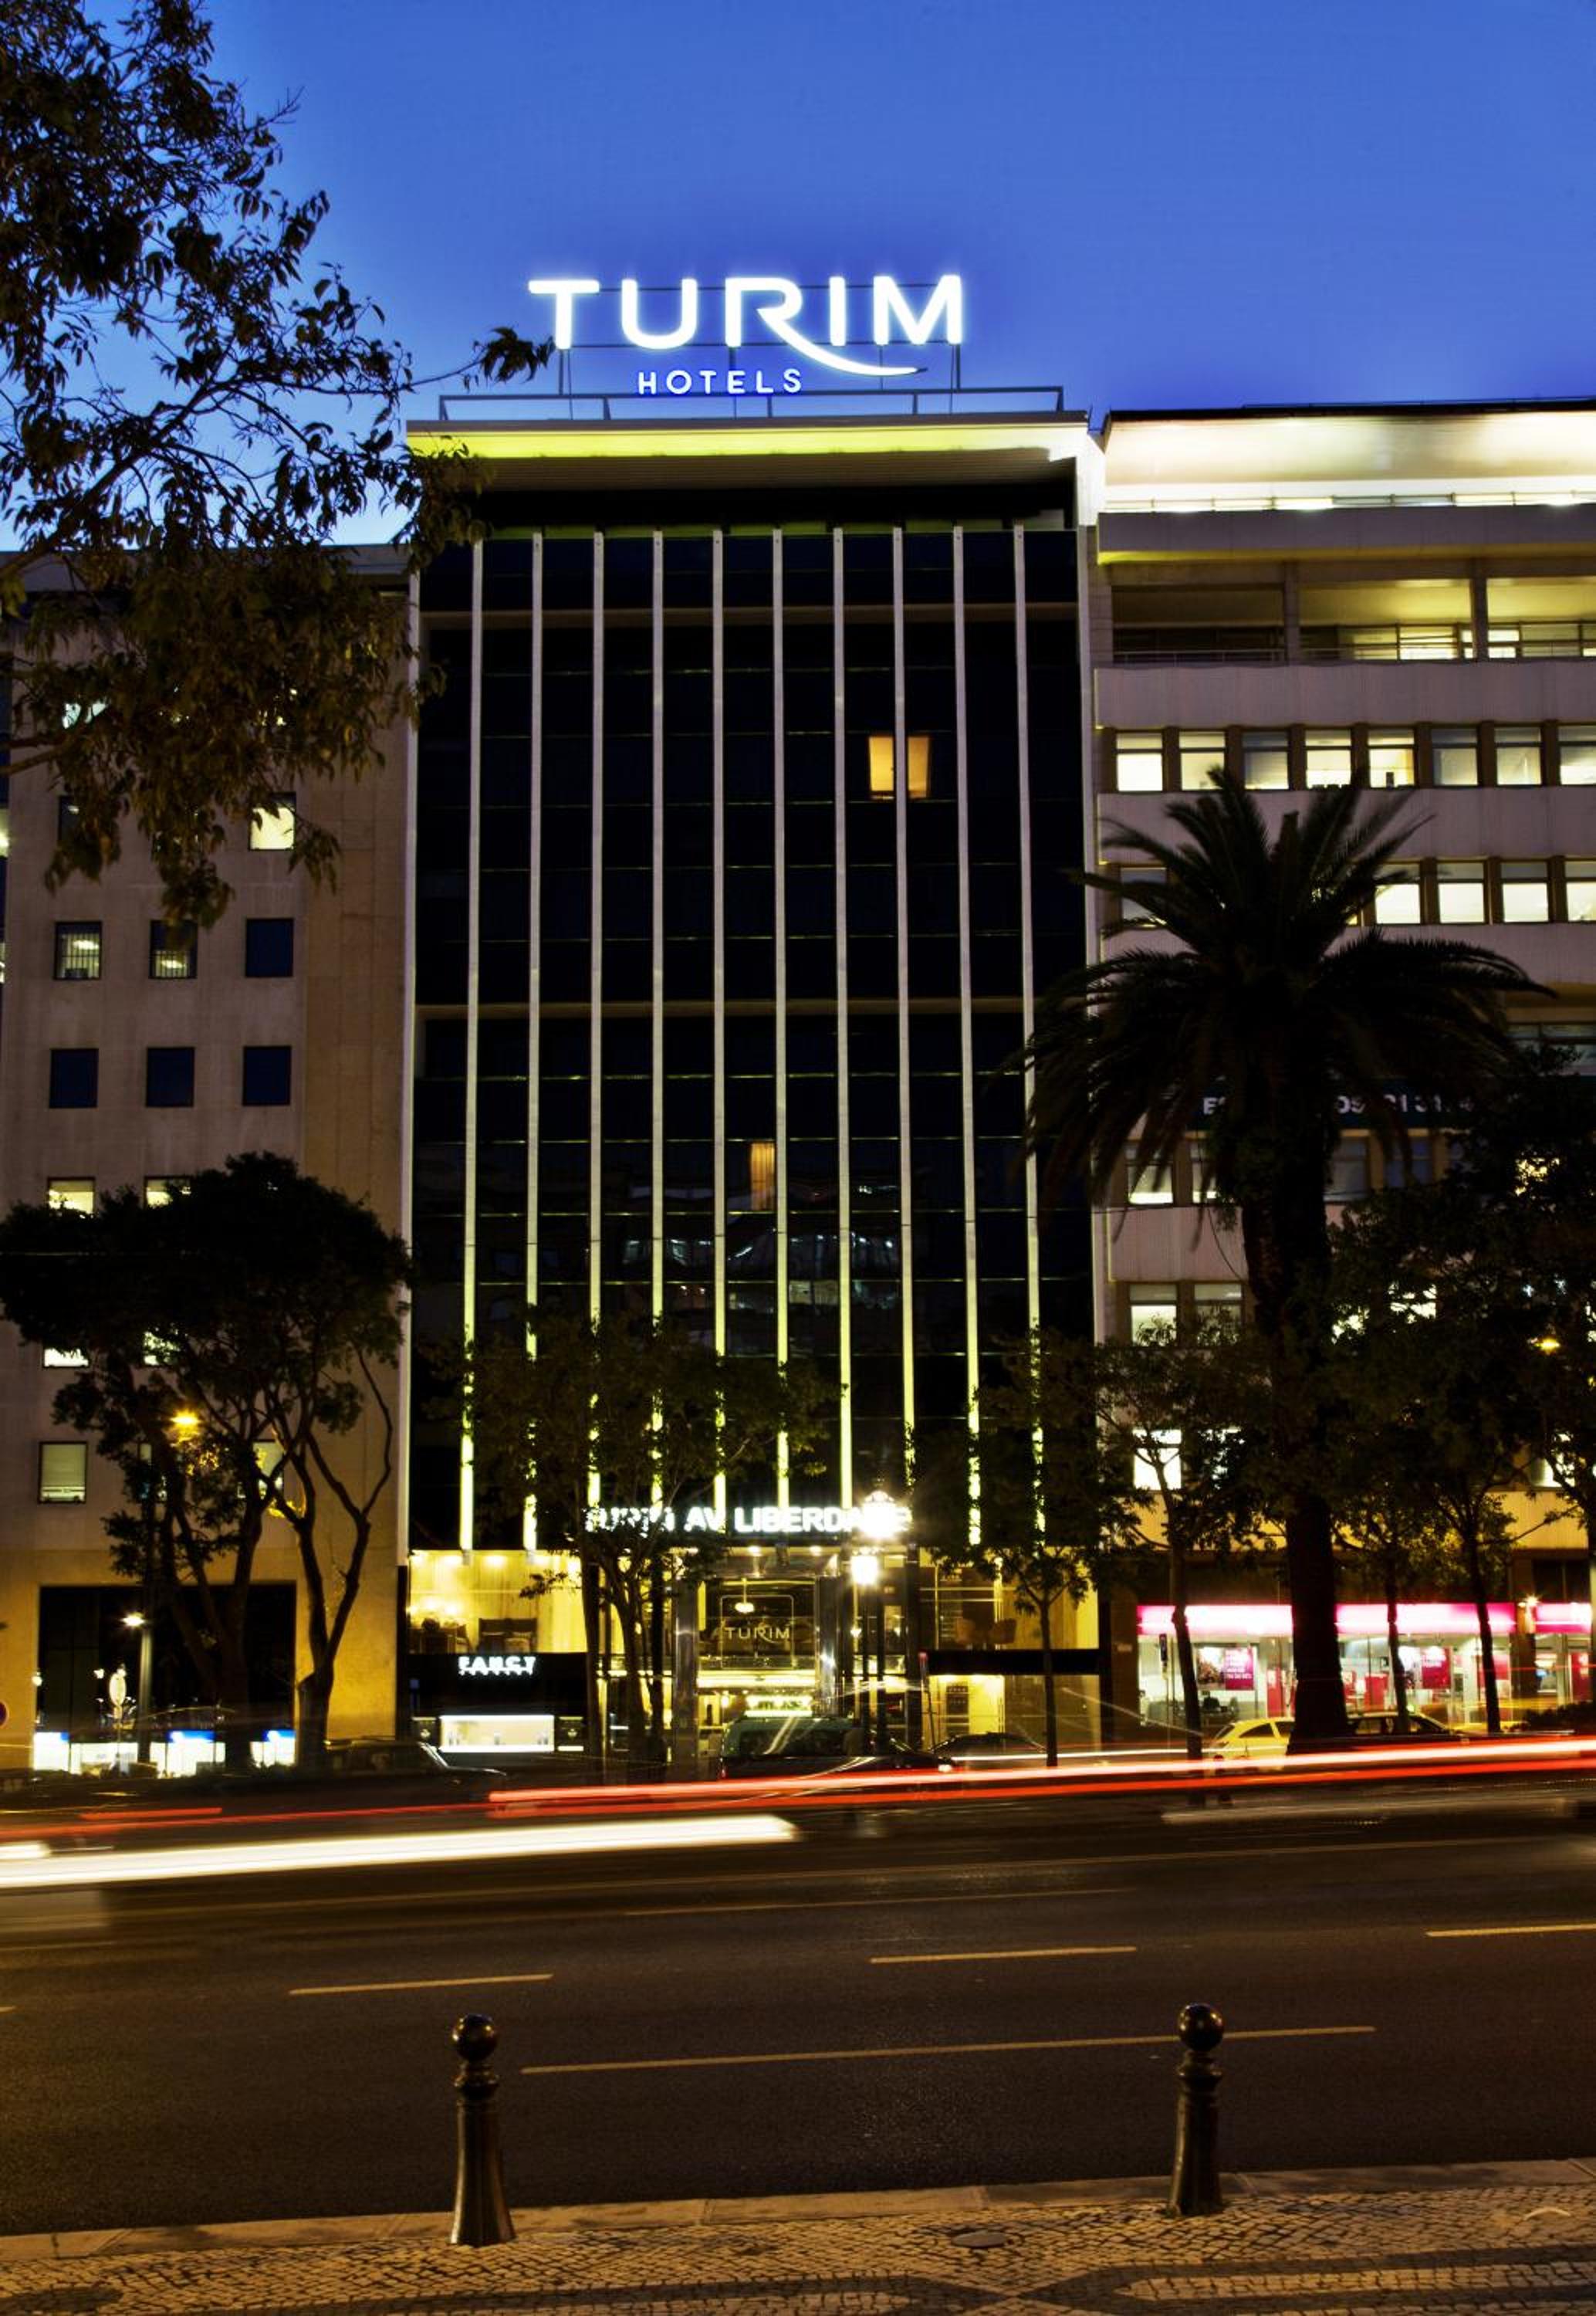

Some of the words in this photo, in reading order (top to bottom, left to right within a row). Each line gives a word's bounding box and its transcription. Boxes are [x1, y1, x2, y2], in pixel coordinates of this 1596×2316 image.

[528, 275, 962, 375] TURIM
[637, 368, 802, 394] HOTELS
[684, 1505, 727, 1533] AV
[724, 1627, 790, 1644] TURIM
